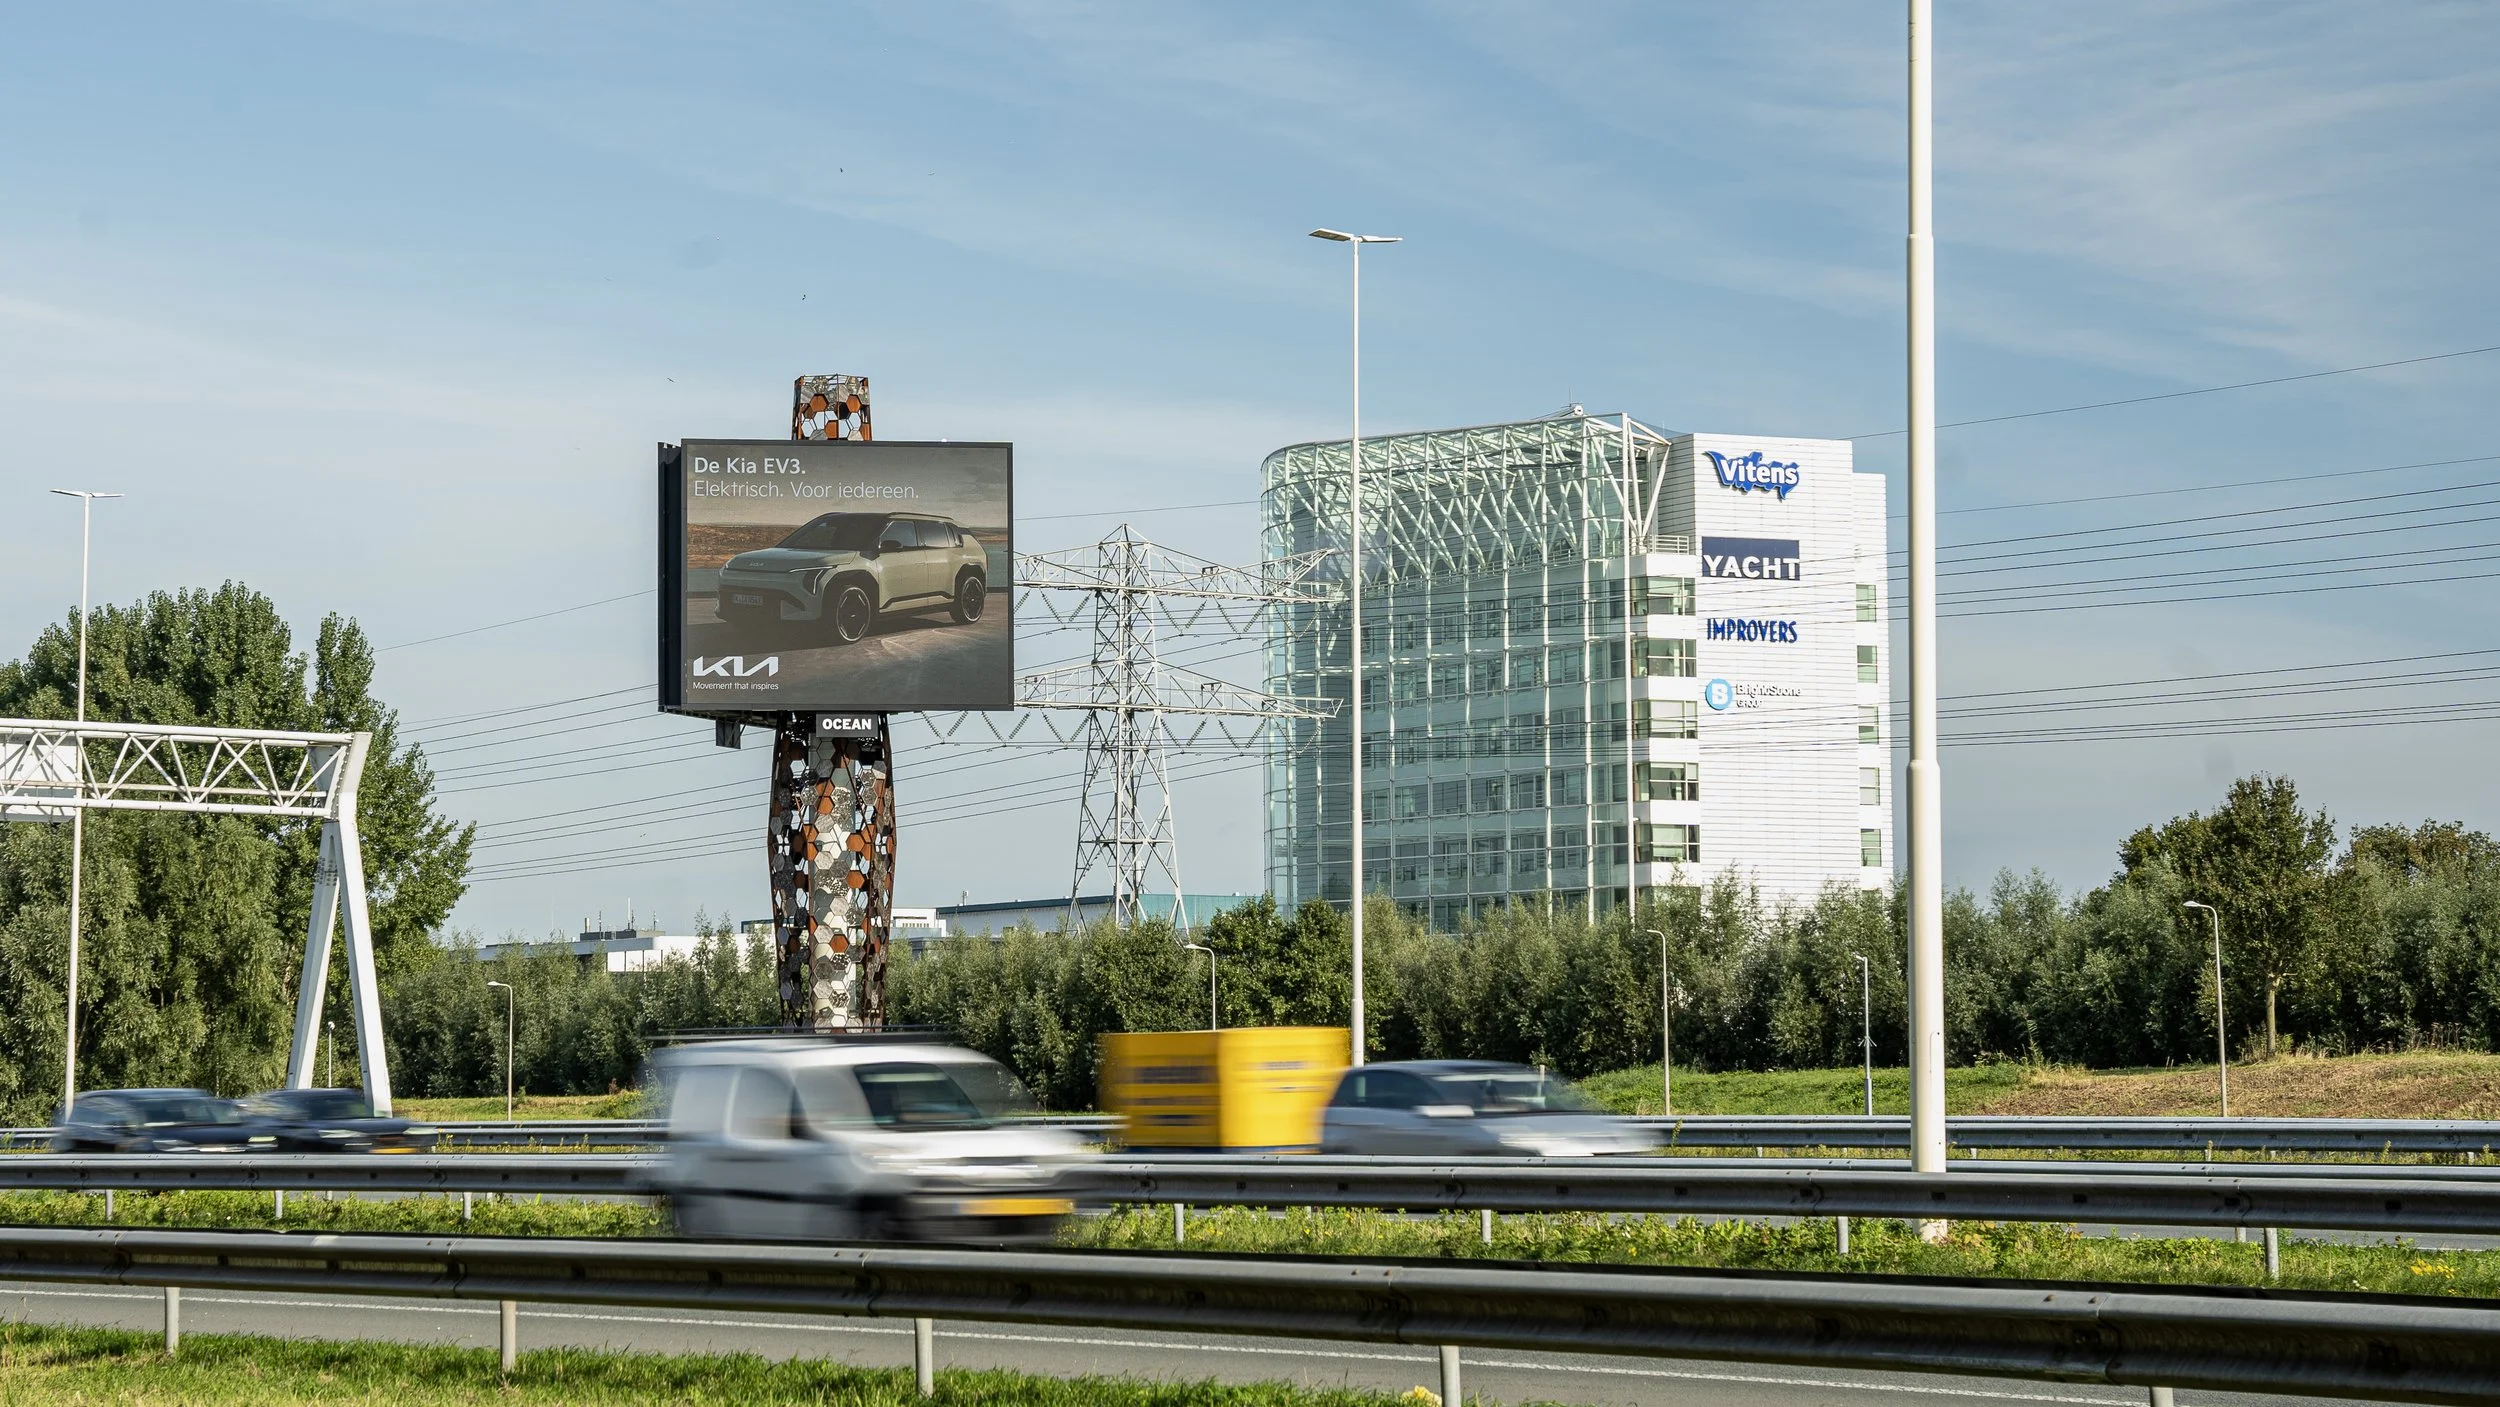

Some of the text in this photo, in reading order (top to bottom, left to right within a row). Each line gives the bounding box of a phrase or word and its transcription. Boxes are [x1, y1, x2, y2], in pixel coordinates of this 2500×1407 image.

[694, 457, 806, 474] De Kia EV3.
[1720, 459, 1798, 485] Vitens
[694, 480, 919, 499] Elektrisch. Voor iedereen.
[1702, 554, 1800, 580] YACHT
[1707, 618, 1798, 643] IMPROVERS
[693, 655, 779, 677] KIA
[693, 681, 779, 691] Movement that inspires
[822, 718, 872, 730] OCEAN
